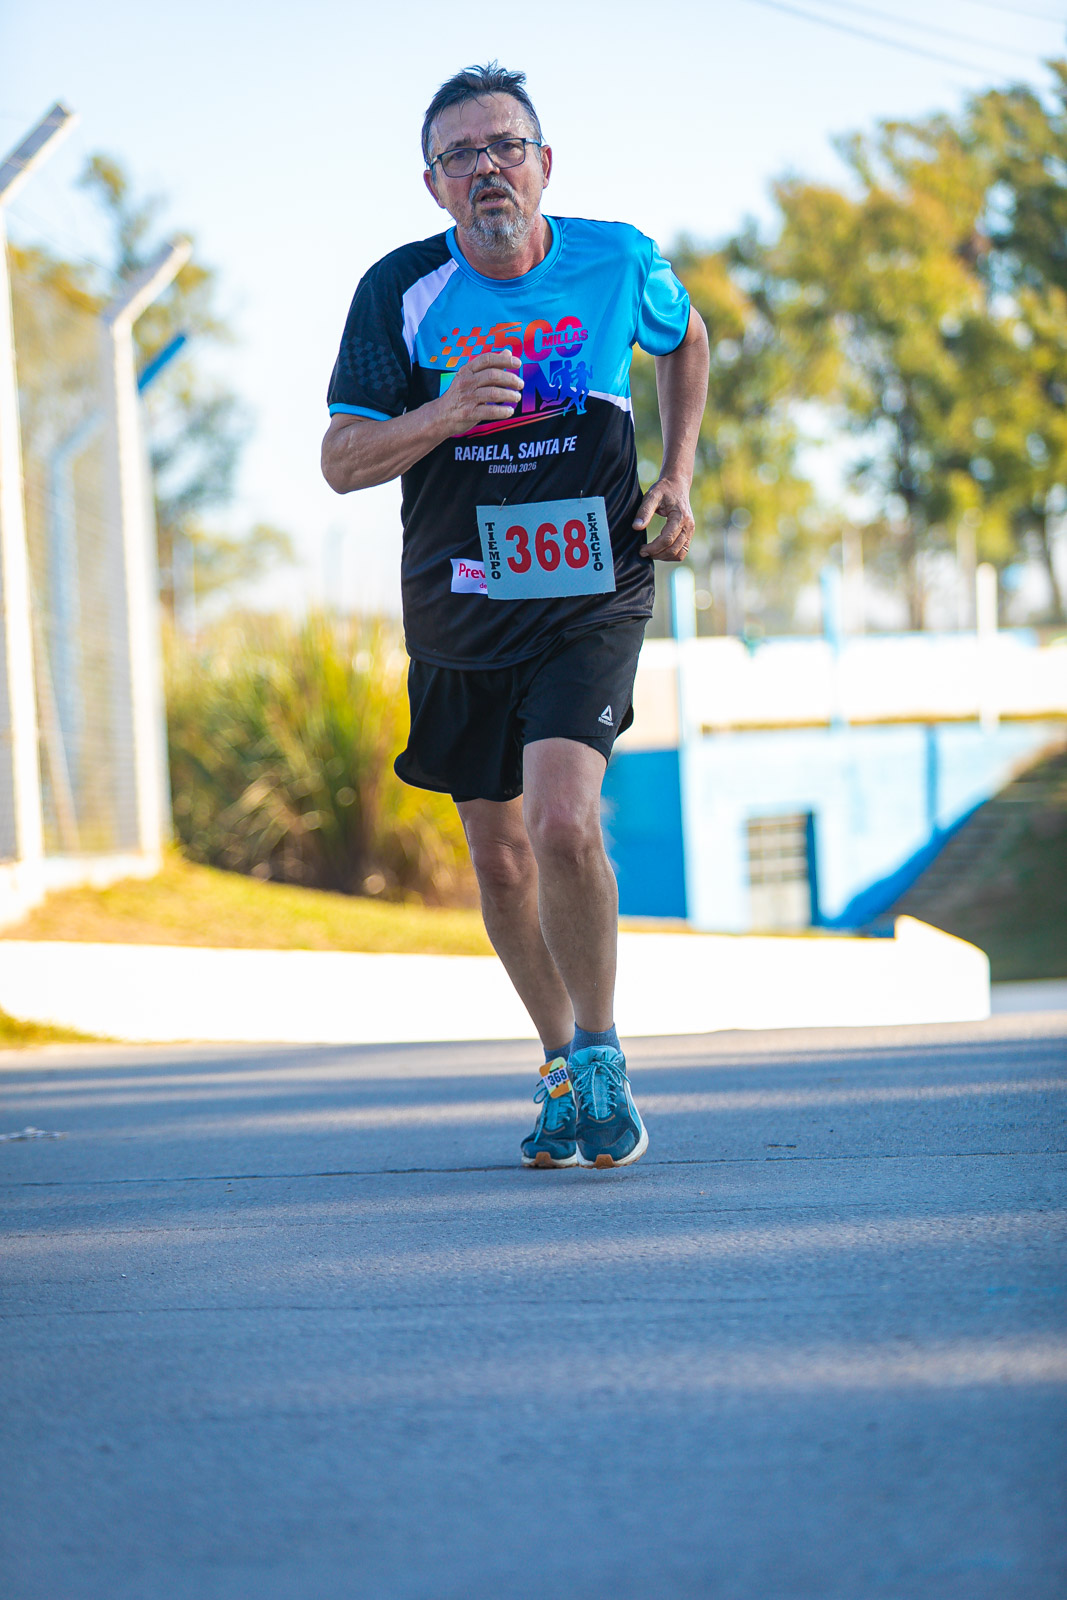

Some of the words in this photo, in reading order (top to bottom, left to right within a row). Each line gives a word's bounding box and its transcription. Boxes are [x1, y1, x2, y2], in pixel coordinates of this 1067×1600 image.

[492, 316, 583, 361] 500
[542, 329, 588, 348] MILLAS
[454, 444, 514, 462] RAFAELA,
[518, 439, 560, 458] SANTA
[562, 435, 578, 453] FE
[488, 463, 517, 474] EDICIÓN
[518, 462, 537, 473] 2026
[485, 522, 501, 580] TIEMPO
[505, 519, 590, 574] 368
[587, 512, 603, 572] EXACTO
[548, 1069, 567, 1086] 368
